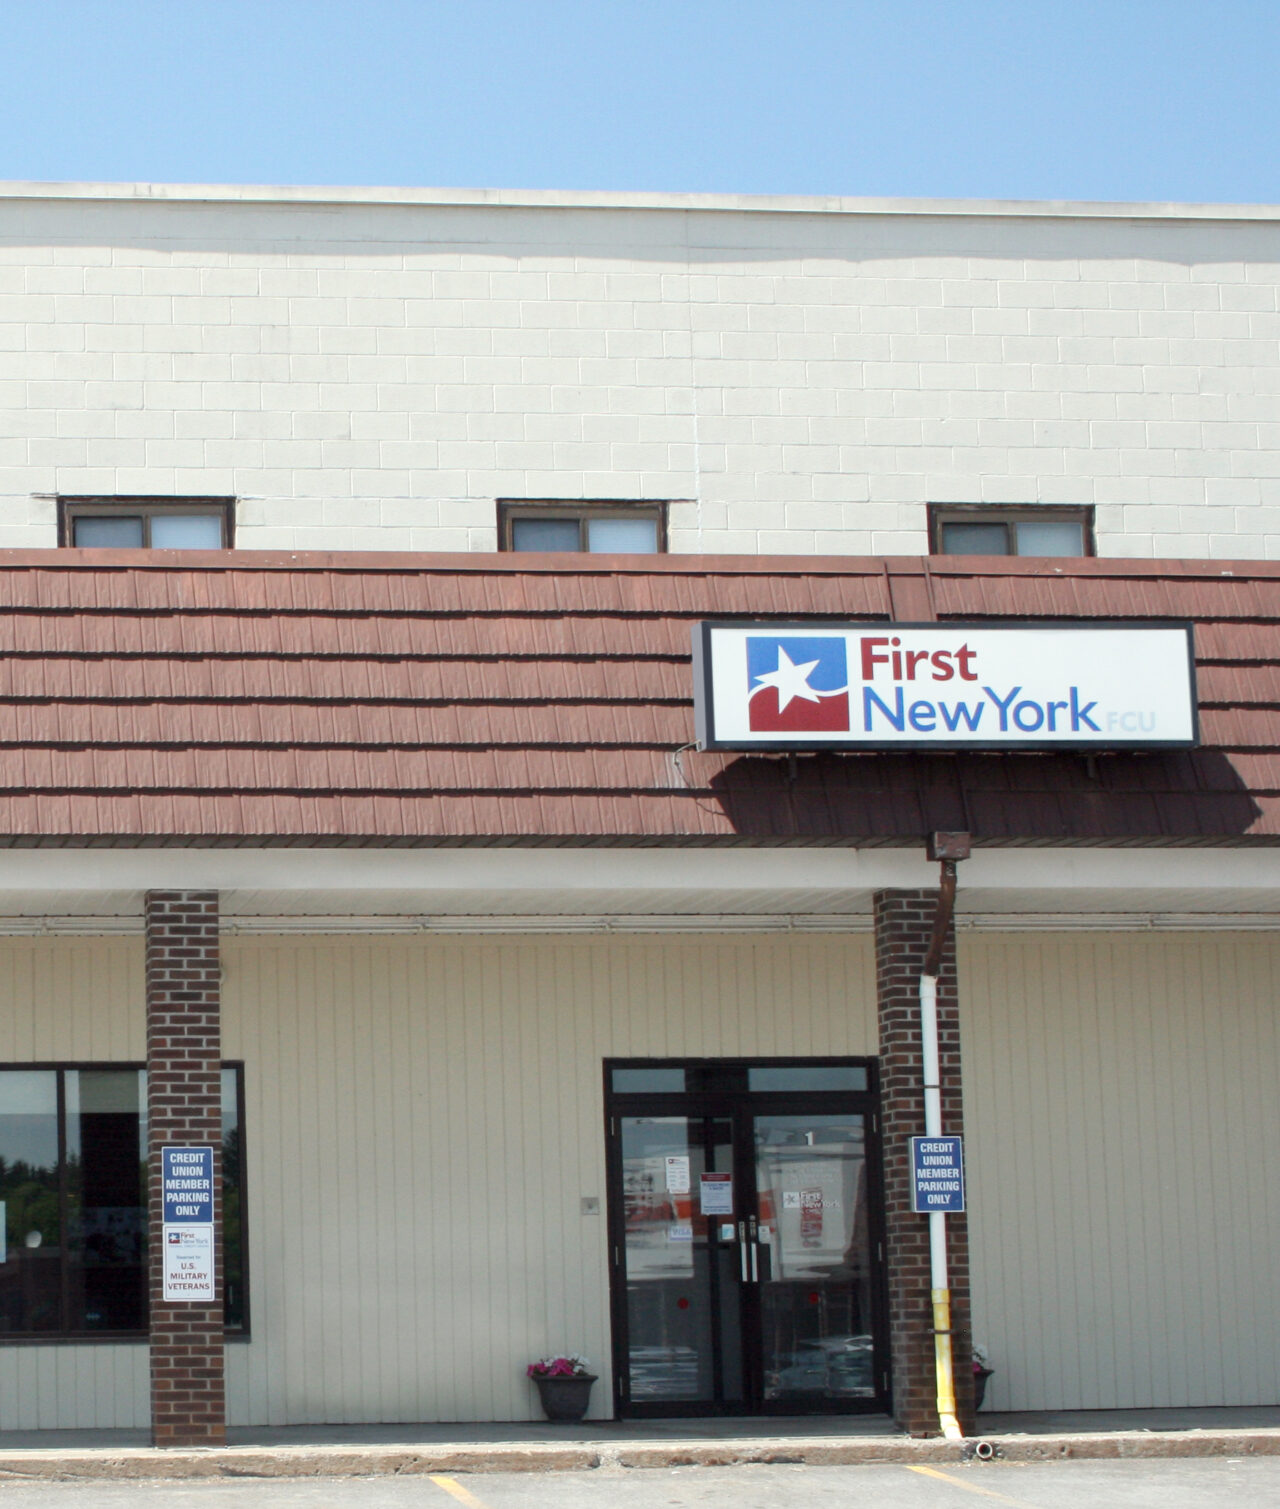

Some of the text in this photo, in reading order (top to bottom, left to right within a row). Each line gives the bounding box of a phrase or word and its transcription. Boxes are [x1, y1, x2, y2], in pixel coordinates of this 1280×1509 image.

[860, 637, 978, 681] First
[1107, 712, 1157, 732] FCU
[805, 1131, 814, 1146] 1
[920, 1142, 954, 1153] CREDIT
[169, 1153, 205, 1163] CREDIT
[923, 1156, 953, 1166] UNION
[172, 1166, 204, 1176] UNION
[917, 1168, 960, 1178] MEMBER
[166, 1179, 210, 1189] MEMBER
[918, 1181, 960, 1192] PARKING
[166, 1193, 210, 1203] PARKING
[800, 1191, 821, 1200] First
[927, 1194, 951, 1204] ONLY
[175, 1206, 200, 1216] ONLY
[168, 1282, 210, 1290] VETERANS
